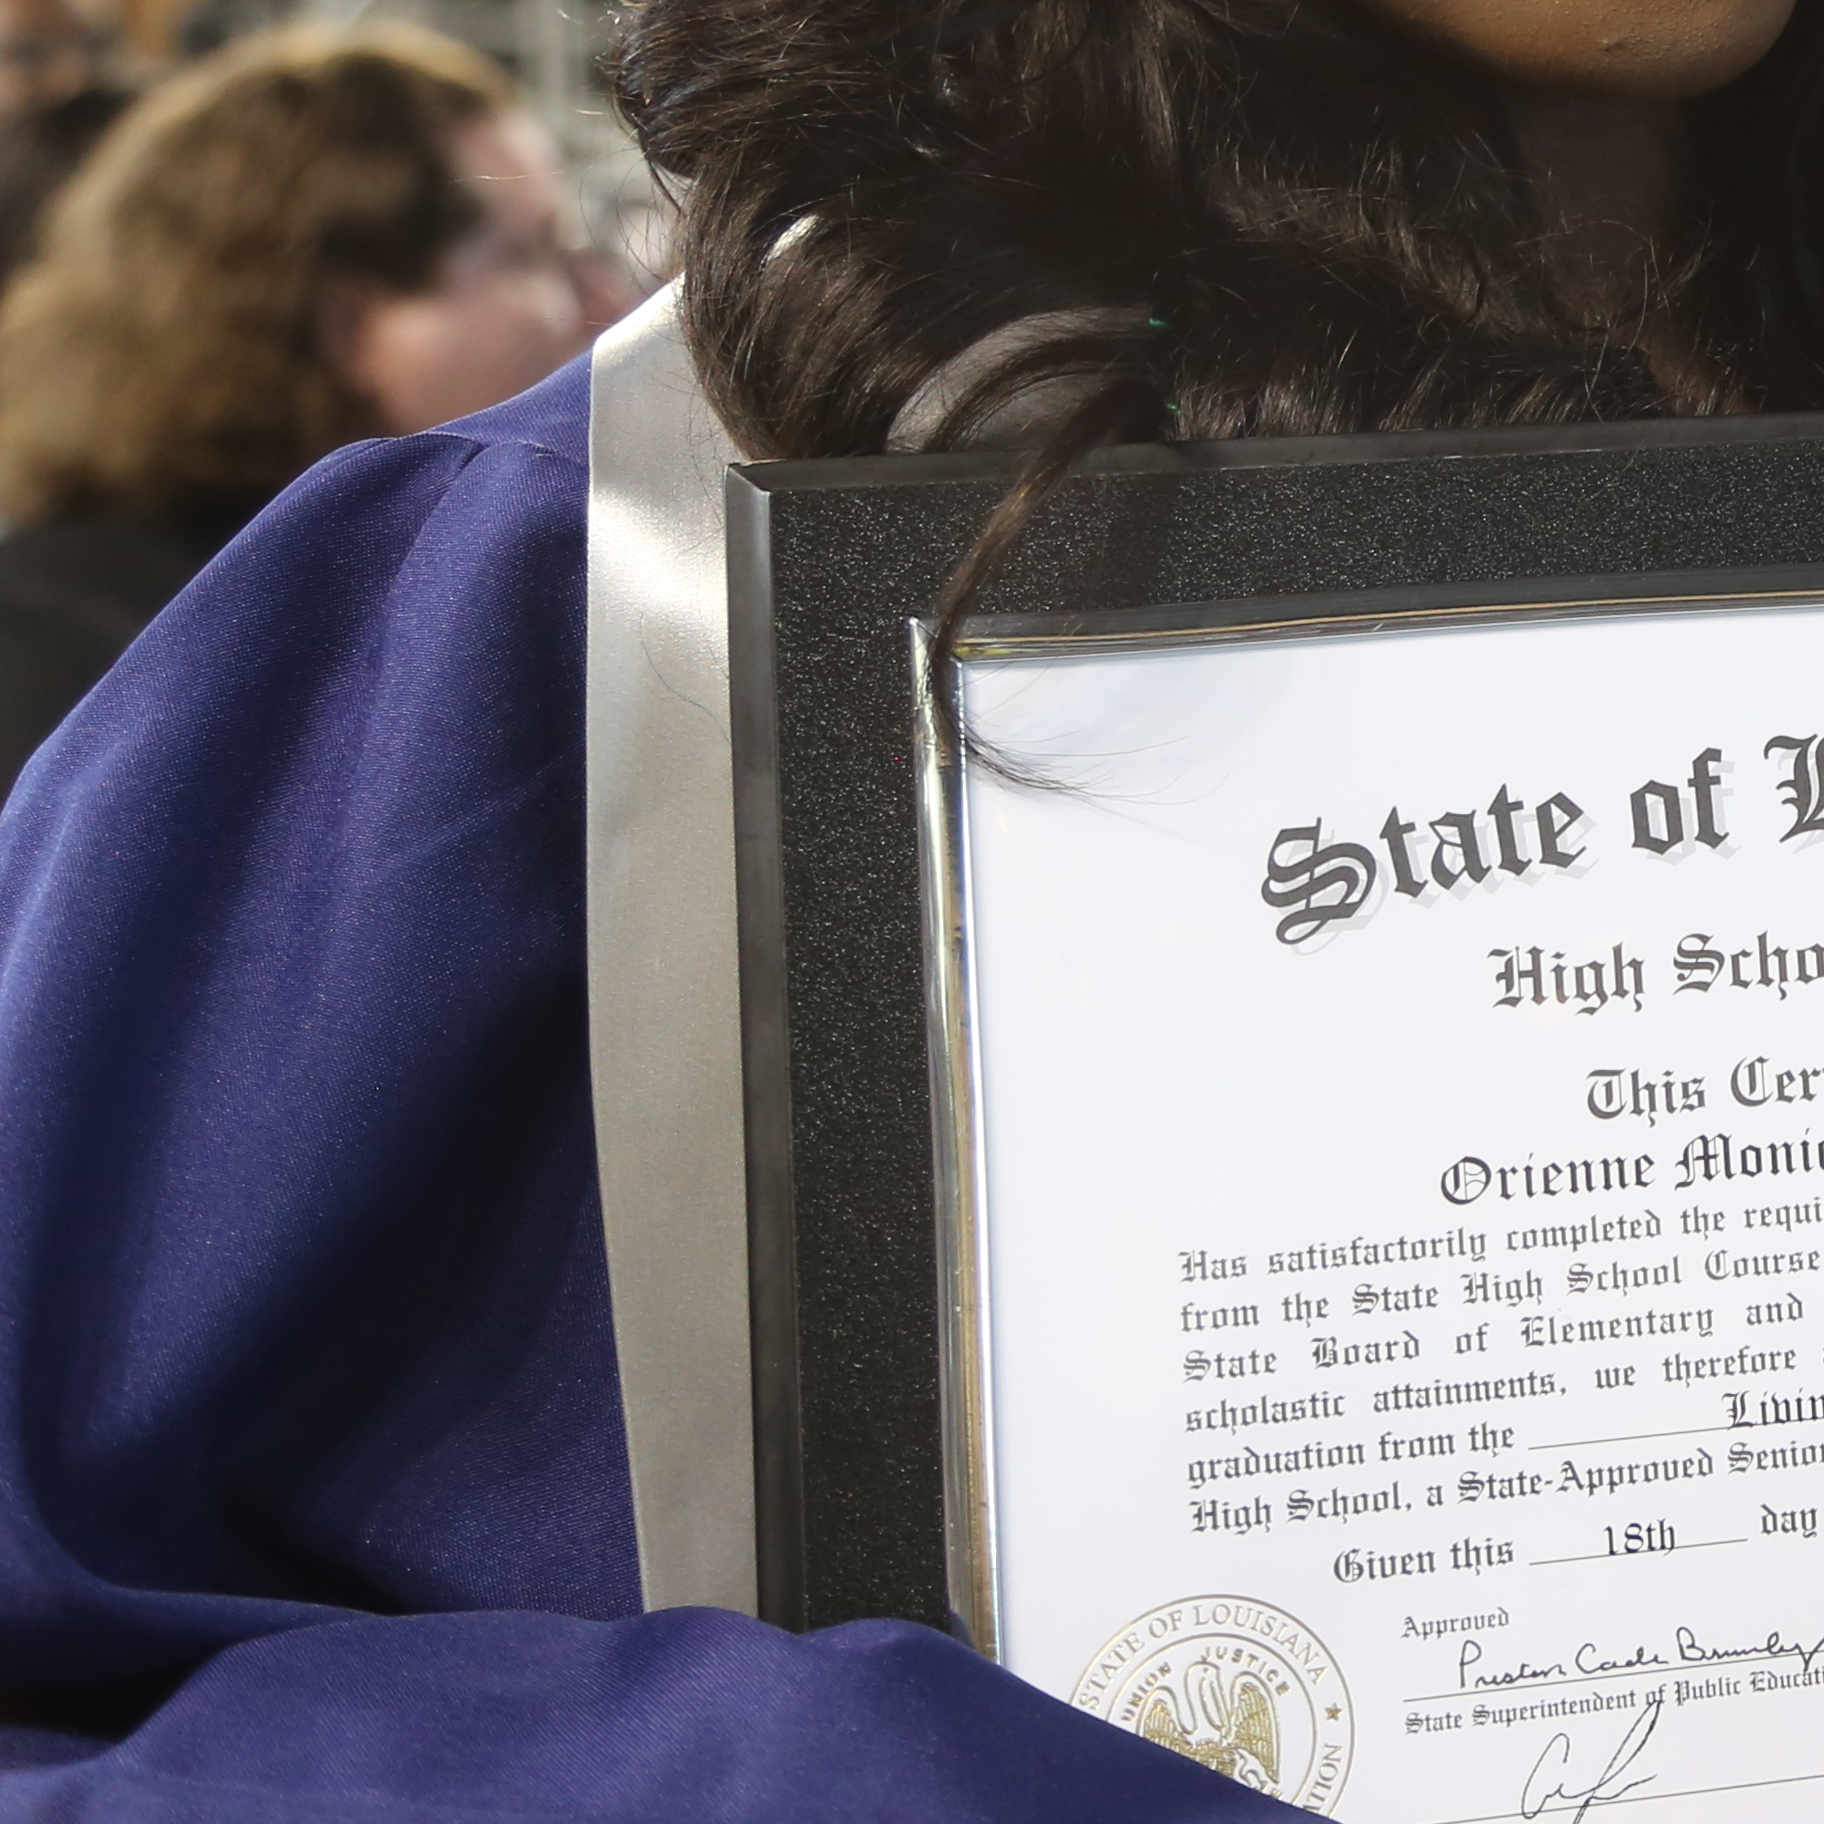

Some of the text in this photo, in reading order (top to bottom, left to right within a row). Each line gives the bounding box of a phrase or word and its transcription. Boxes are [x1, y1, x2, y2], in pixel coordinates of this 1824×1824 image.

[1260, 783, 1587, 946] State
[1629, 747, 1730, 856] of
[1487, 942, 1645, 1016] High
[1586, 1068, 1706, 1128] This
[1440, 1152, 1656, 1206] Orienne
[1178, 1249, 1247, 1283] Has
[1267, 1226, 1487, 1279] satisfactorily
[1506, 1208, 1662, 1253] completed
[1679, 1205, 1726, 1241] the
[1180, 1301, 1260, 1333] from
[1281, 1291, 1330, 1329] the
[1351, 1283, 1439, 1316] State
[1459, 1269, 1543, 1308] High
[1566, 1255, 1682, 1297] School
[1704, 1249, 1821, 1281] Course
[1182, 1348, 1278, 1382] State
[1310, 1329, 1420, 1369] Board
[1455, 1321, 1490, 1355] of
[1520, 1308, 1714, 1348] Elementary
[1745, 1291, 1804, 1327] and
[1185, 1390, 1346, 1436] scholastic
[1373, 1370, 1567, 1414] attainments,
[1594, 1365, 1636, 1390] we
[1661, 1344, 1797, 1389] therefore
[1187, 1440, 1366, 1490] graduation
[1378, 1430, 1457, 1463] from
[1467, 1421, 1515, 1459] the
[1188, 1495, 1272, 1536] High
[1286, 1480, 1413, 1525] School,
[1426, 1484, 1445, 1508] a
[1457, 1447, 1714, 1504] State-Approved
[1333, 1548, 1437, 1584] Given
[1449, 1536, 1514, 1576] this
[1603, 1518, 1676, 1561] 18th
[1759, 1503, 1818, 1539] day
[1079, 1604, 1329, 1709] STATE OF LOUISIANA
[1401, 1606, 1510, 1641] Approved
[1121, 1661, 1172, 1722] UNION
[1202, 1646, 1290, 1697] JUSTICE
[1404, 1711, 1463, 1734] State
[1471, 1689, 1637, 1728] Superintendent
[1646, 1684, 1666, 1707] of
[1673, 1676, 1741, 1707] Public
